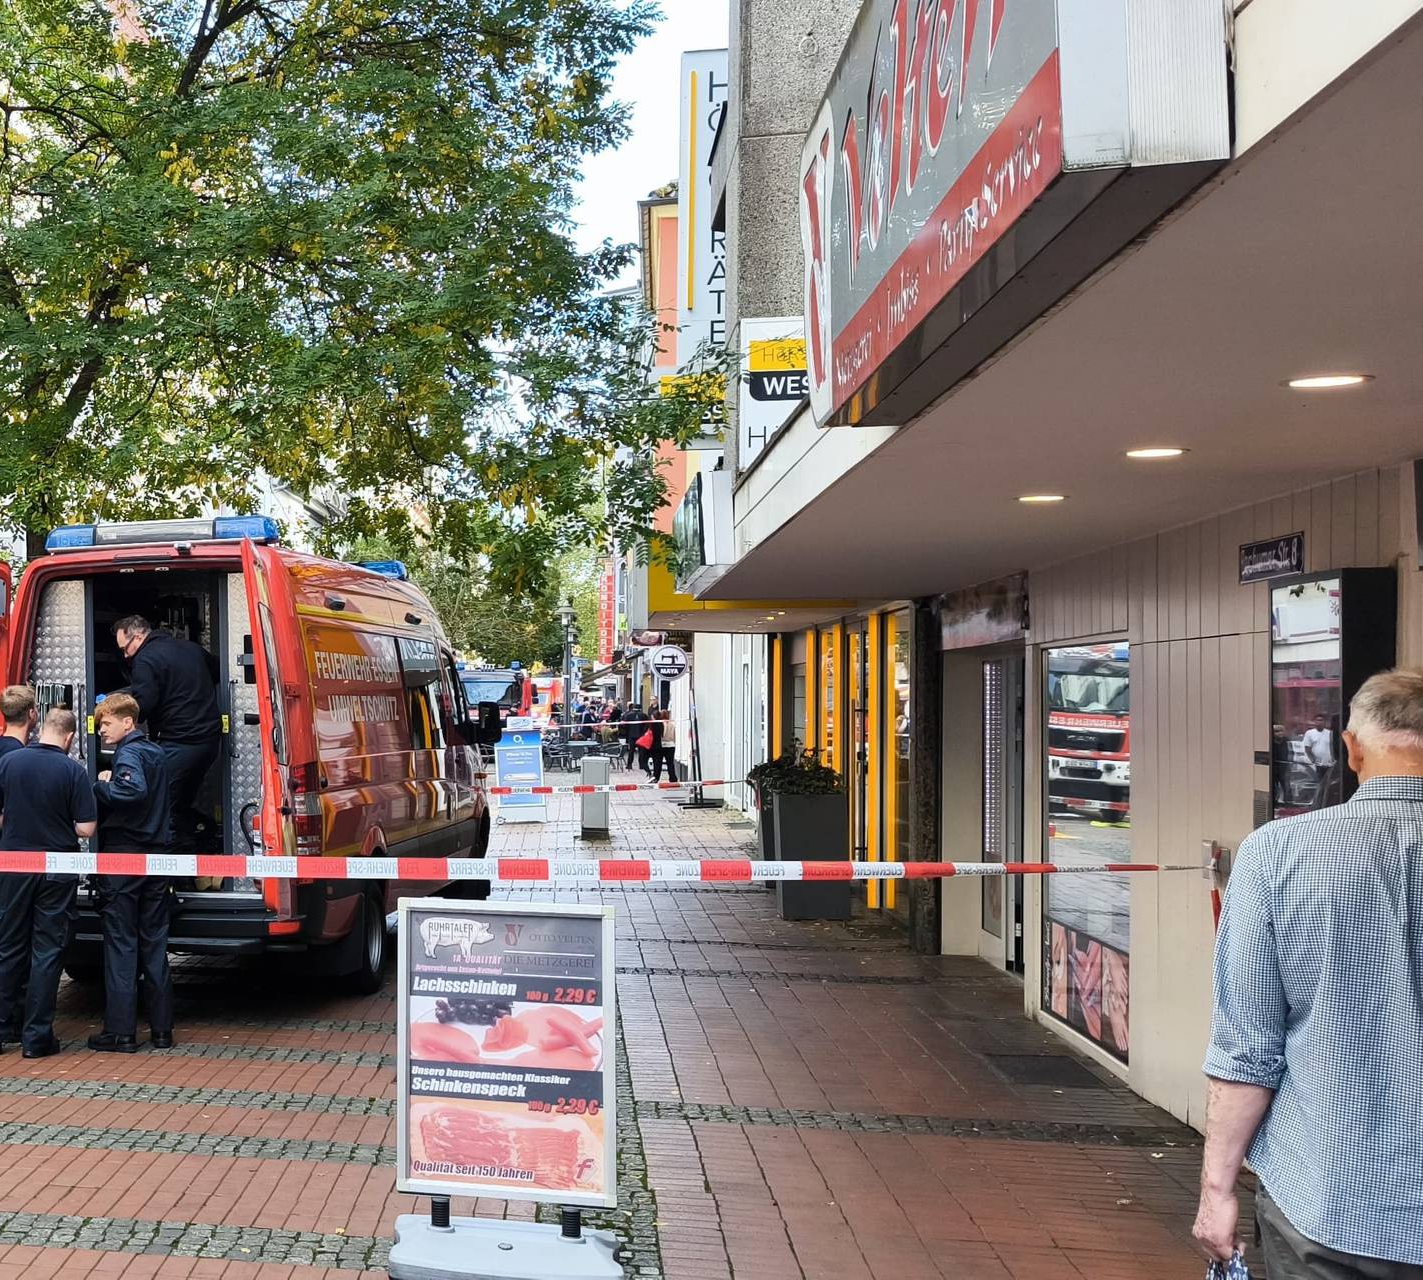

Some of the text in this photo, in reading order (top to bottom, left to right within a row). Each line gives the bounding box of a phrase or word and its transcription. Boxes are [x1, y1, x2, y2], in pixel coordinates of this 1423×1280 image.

[1291, 537, 1298, 566] 8
[314, 651, 373, 682] FEUERWEHR
[327, 695, 400, 723] UMWELTSCHUTZ
[428, 921, 474, 938] RUHRTALER
[503, 954, 595, 969] DIE METZGEREI
[413, 976, 517, 996] Lachsschinken
[554, 986, 585, 1004] 2,29
[412, 1066, 571, 1086] Unsere hausgemachten Klassiker
[411, 1077, 527, 1098] Schinkenspeck
[556, 1097, 588, 1115] 2,29
[413, 1160, 534, 1181] Qualität seit 150 Jahren
